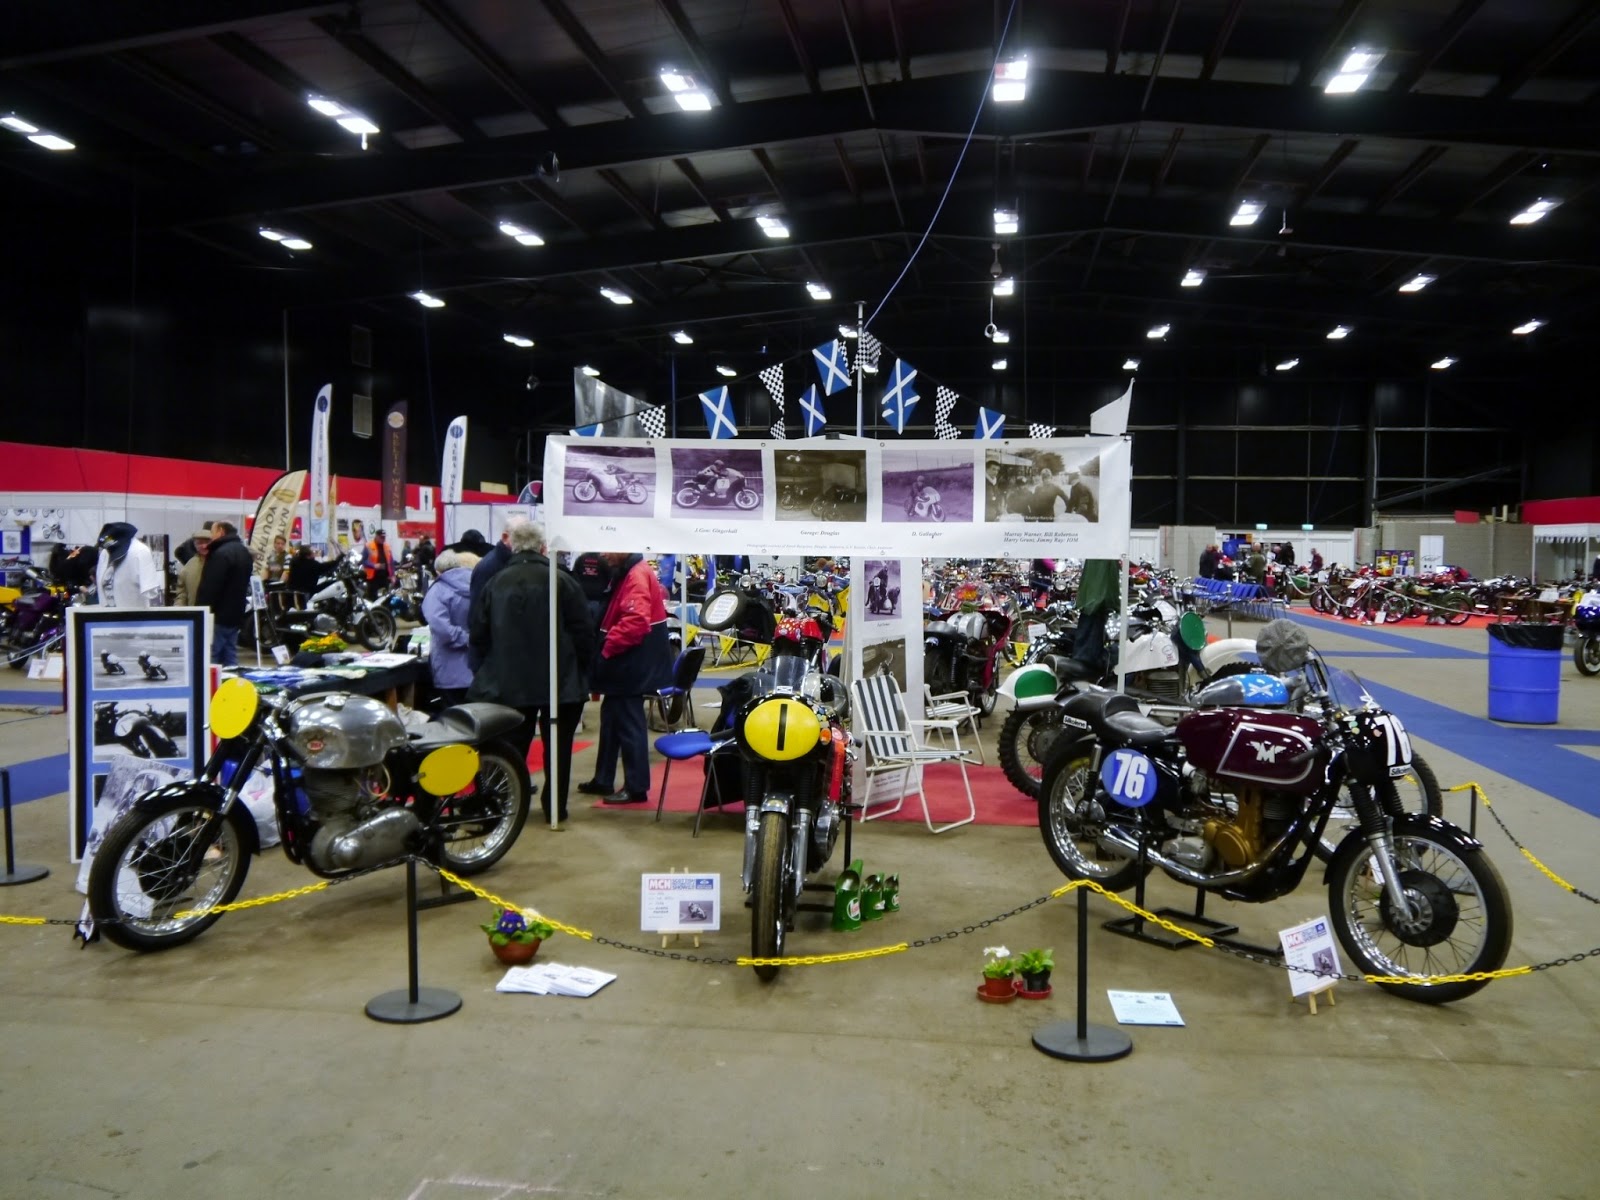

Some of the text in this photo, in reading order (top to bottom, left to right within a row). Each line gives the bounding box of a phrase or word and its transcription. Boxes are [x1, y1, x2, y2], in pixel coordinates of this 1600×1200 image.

[254, 501, 278, 576] YOUTHBIK
[919, 531, 943, 539] Gallagher
[1373, 715, 1413, 767] 76
[1112, 752, 1149, 800] 76
[649, 879, 671, 890] MCN
